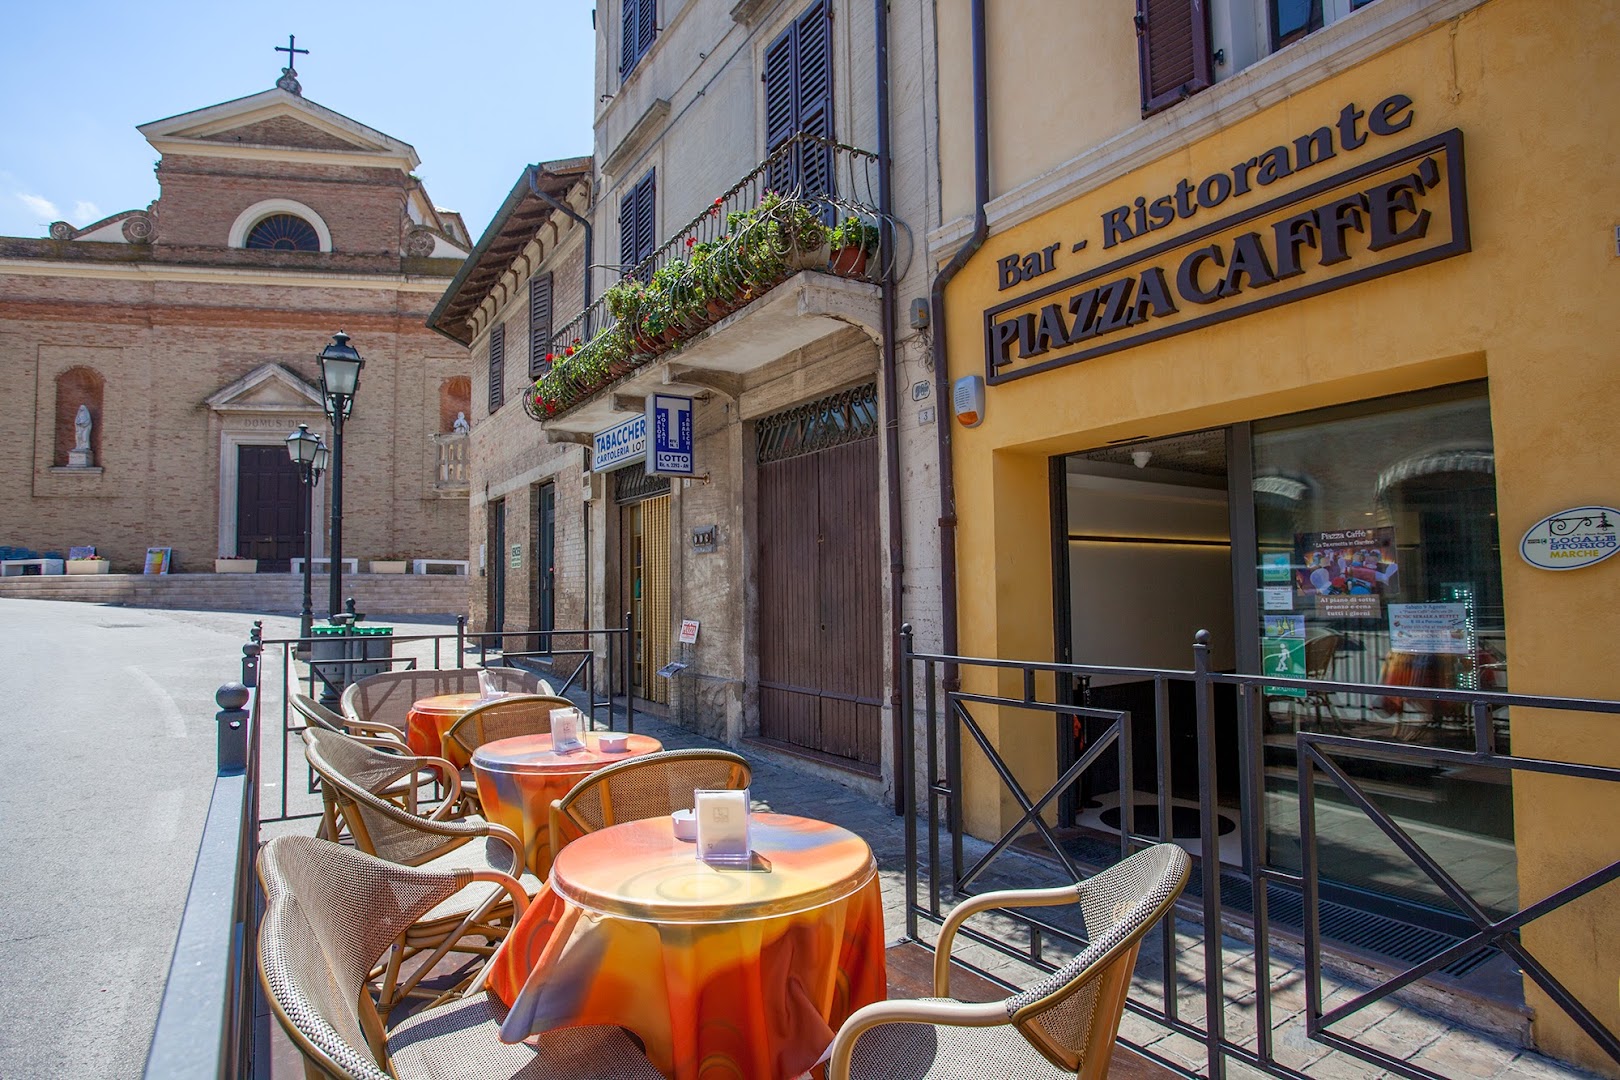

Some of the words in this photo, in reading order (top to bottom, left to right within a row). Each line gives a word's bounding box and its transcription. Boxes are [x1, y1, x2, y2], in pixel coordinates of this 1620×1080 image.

[997, 240, 1061, 292] Bar
[1101, 94, 1415, 250] Ristorante
[991, 266, 1180, 368] PIAZZA
[1176, 157, 1441, 305] CAFFE'
[923, 411, 928, 421] 3
[244, 419, 282, 428] DOMUS
[597, 446, 629, 464] CARTOLERIA
[660, 454, 688, 462] LOTTO
[1321, 532, 1345, 540] Piazza
[1550, 535, 1616, 544] LOCALE
[1550, 541, 1616, 550] STORICO
[1550, 550, 1599, 558] MARCHE
